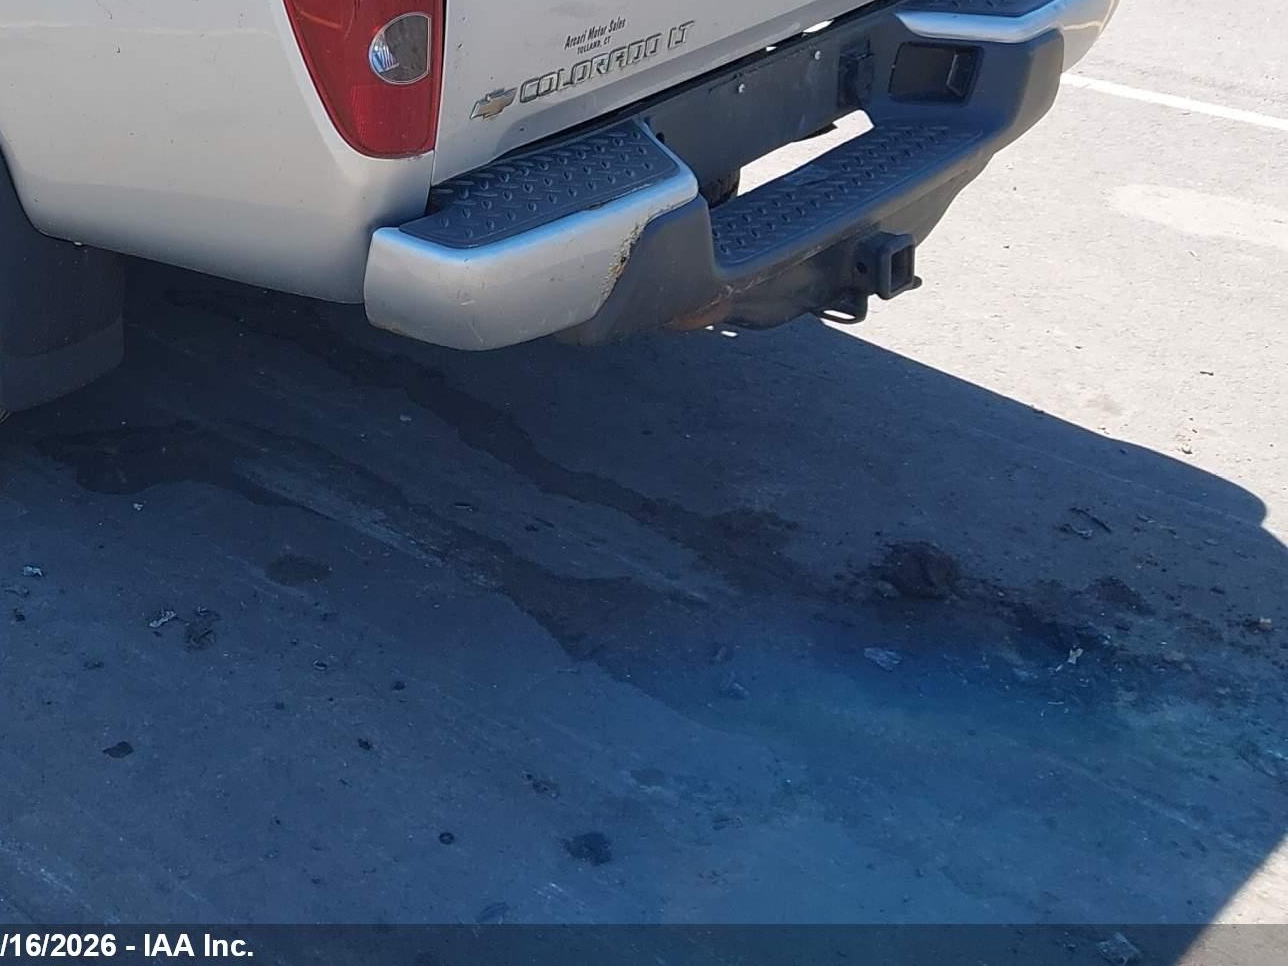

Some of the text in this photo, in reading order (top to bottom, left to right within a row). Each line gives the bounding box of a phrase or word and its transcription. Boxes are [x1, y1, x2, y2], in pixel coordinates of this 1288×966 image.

[588, 25, 607, 41] Motor
[608, 16, 626, 33] Sales
[603, 36, 611, 45] CT
[520, 20, 695, 103] COLORADO LT
